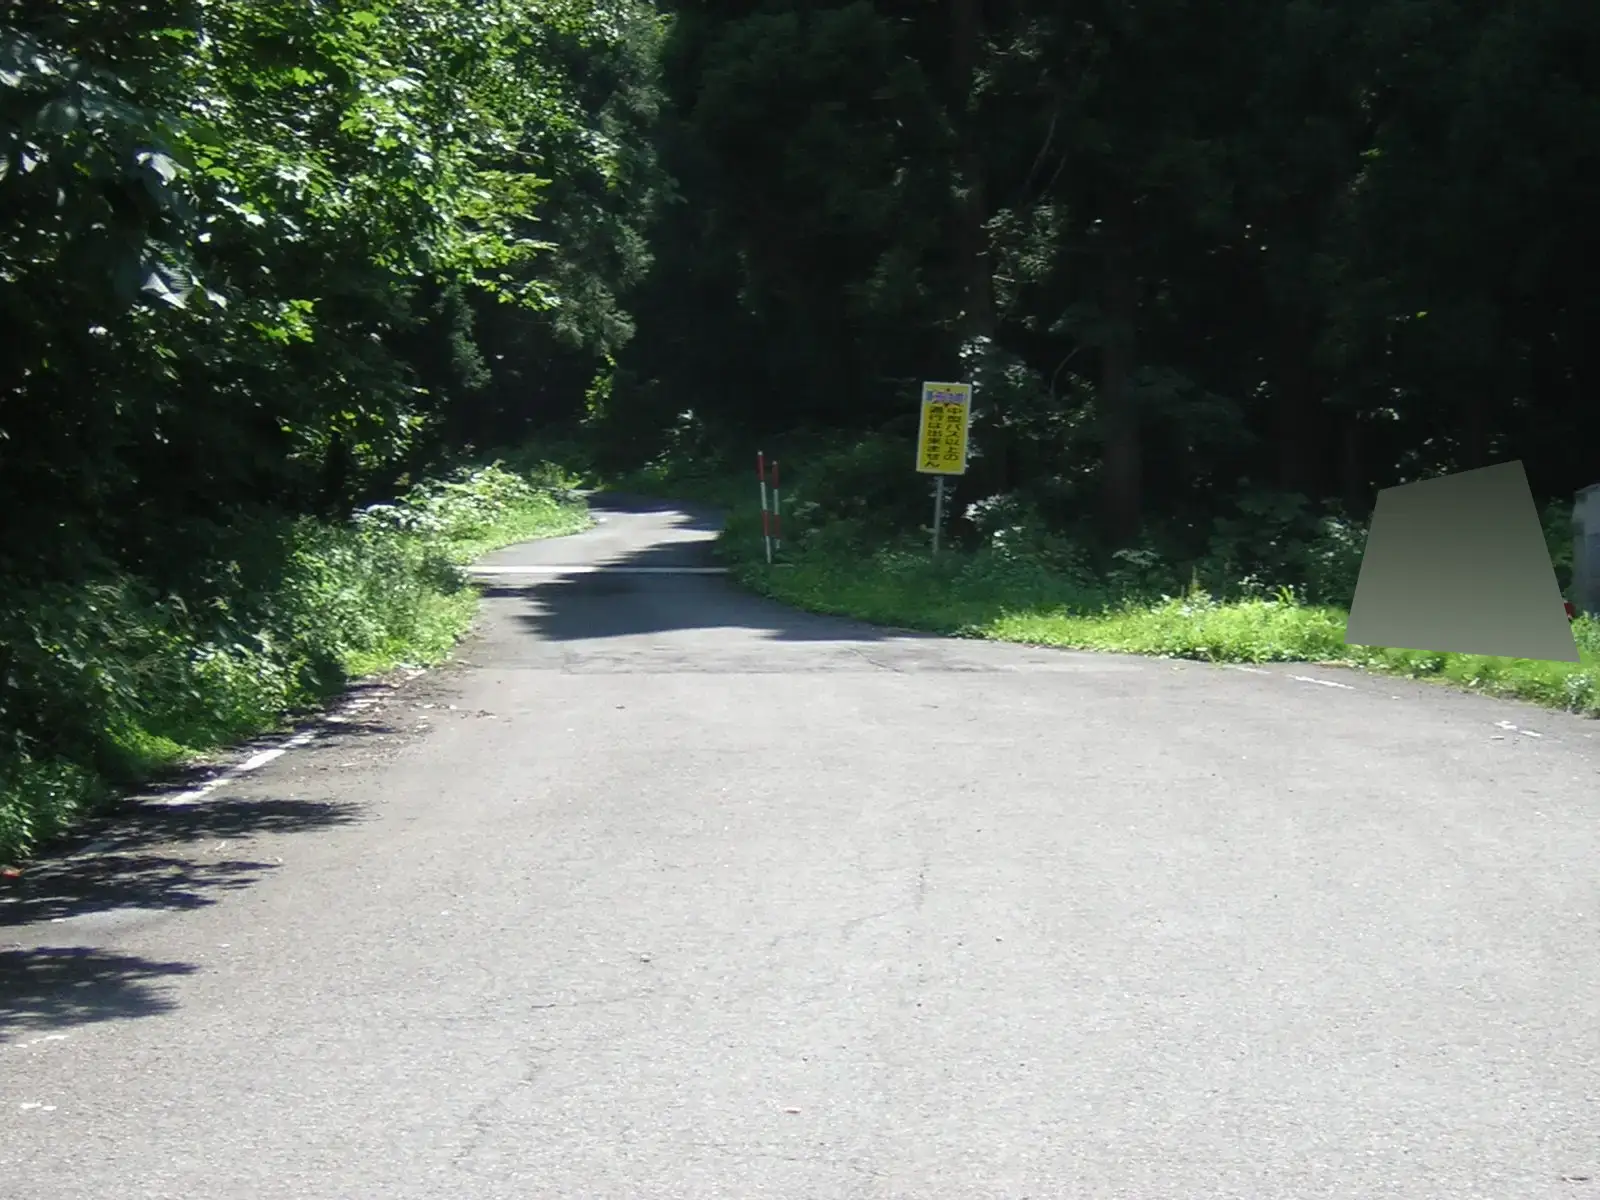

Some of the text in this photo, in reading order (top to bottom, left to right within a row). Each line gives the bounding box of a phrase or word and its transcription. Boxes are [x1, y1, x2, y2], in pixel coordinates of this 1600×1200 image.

[924, 406, 944, 468] 通行は出来ません
[943, 407, 963, 461] 中型バス以上の
